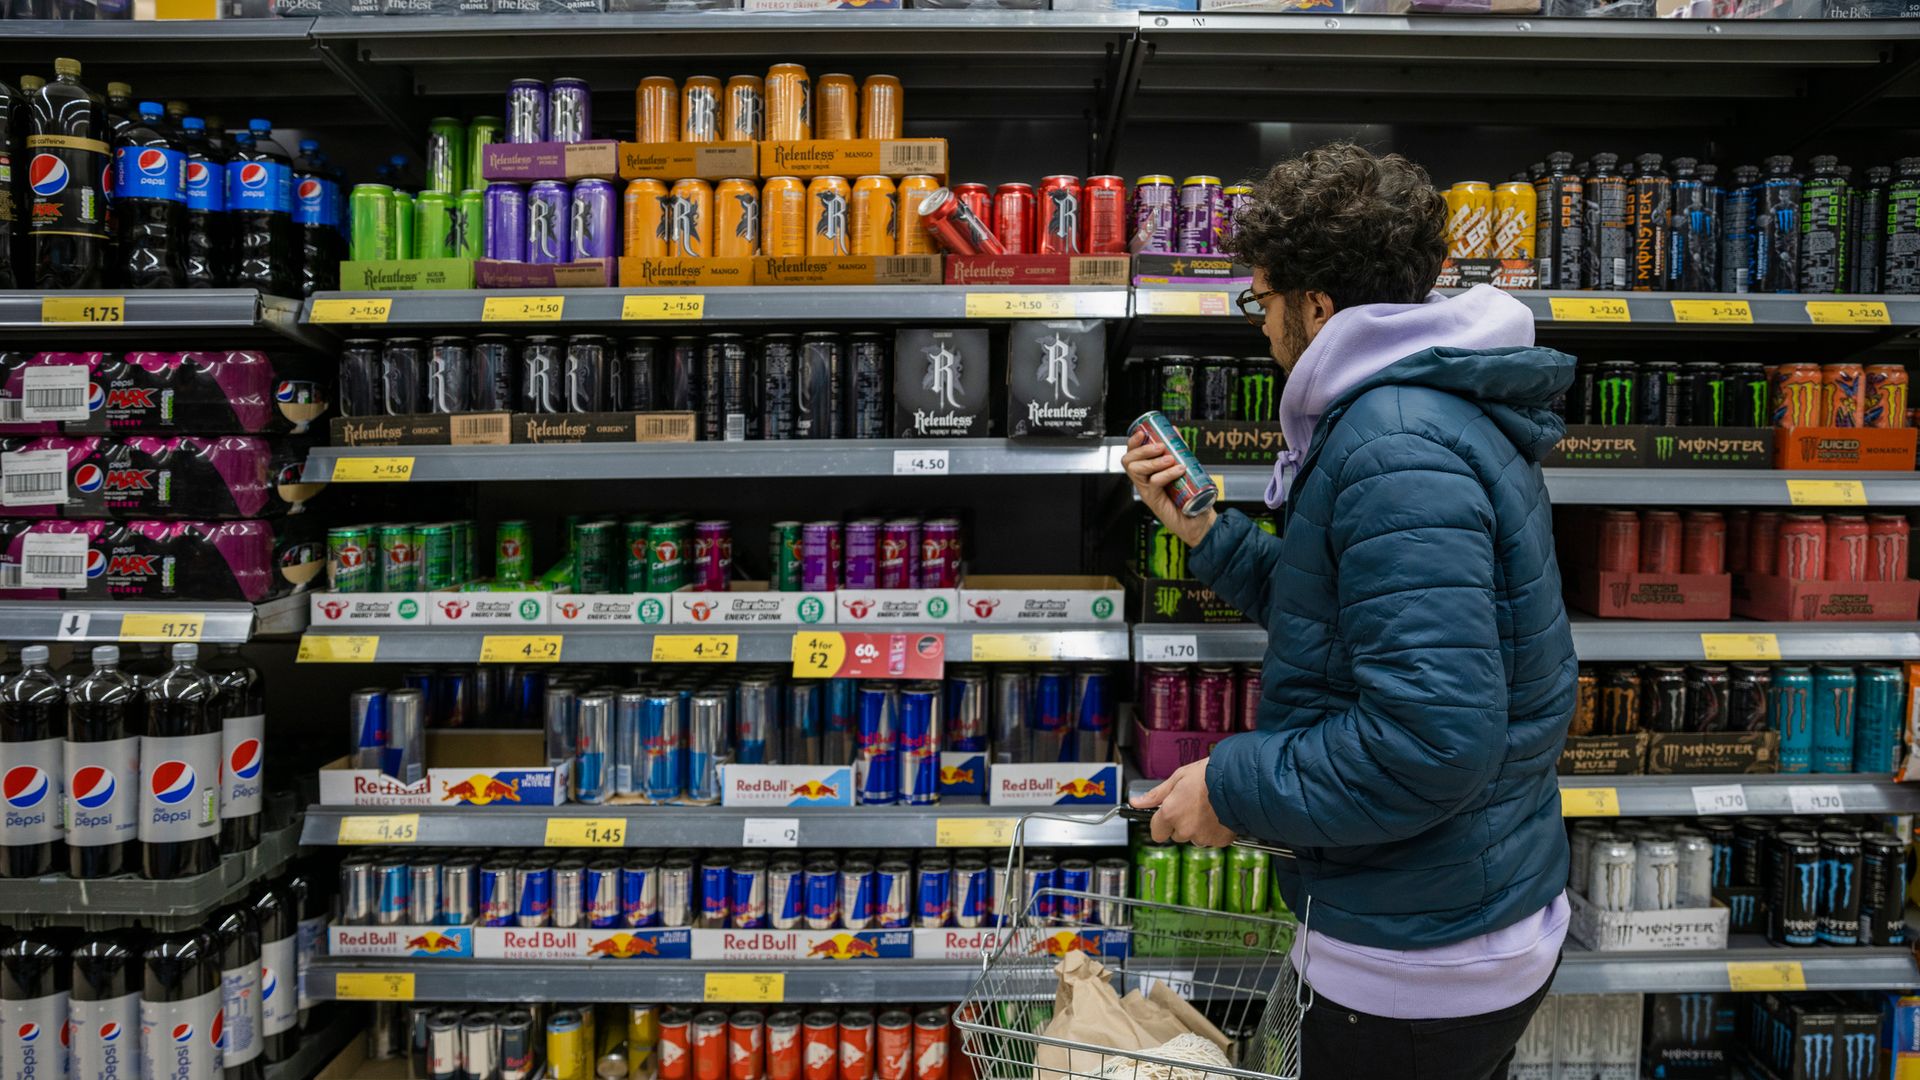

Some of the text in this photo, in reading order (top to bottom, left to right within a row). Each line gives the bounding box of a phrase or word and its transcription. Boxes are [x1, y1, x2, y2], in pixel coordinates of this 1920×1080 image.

[409, 0, 433, 10] Best
[498, 0, 540, 10] the Best
[1831, 6, 1848, 18] the
[627, 154, 667, 170] Relentless
[774, 145, 834, 169] Relentless
[1637, 191, 1653, 279] MONSTER
[642, 259, 701, 284] Relentless
[767, 257, 828, 281] Relentless
[954, 260, 1015, 284] Relentless
[364, 268, 417, 290] Relentless
[1491, 276, 1537, 287] ALERT
[350, 307, 385, 315] 2 £1.50
[523, 304, 559, 313] 2 £1.50
[663, 302, 699, 311] 2 £1.50
[1006, 301, 1042, 310] 2 £1.50
[1590, 306, 1624, 314] 2 £2.50
[1712, 308, 1747, 316] 2 £2.50
[83, 307, 119, 322] £1.75
[1848, 309, 1883, 318] 2 £2.50
[111, 380, 134, 388] pepsi
[105, 388, 159, 409] MAX
[1027, 400, 1088, 427] Relentless
[913, 408, 973, 435] Relentless
[343, 422, 402, 446] Relentless
[527, 418, 586, 443] Relentless
[1554, 436, 1636, 452] MONSTER
[1678, 437, 1765, 453] MONSTER
[1818, 440, 1859, 449] JUICED
[109, 461, 131, 469] pepsi
[373, 465, 408, 474] 2 £1.50
[912, 459, 945, 469] £4.50
[103, 469, 156, 489] MAX
[112, 546, 135, 554] pepsi
[106, 555, 160, 575] MAX
[523, 604, 536, 613] 63
[642, 604, 659, 616] 63
[802, 602, 819, 615] 63
[932, 603, 945, 612] 63
[1096, 602, 1110, 611] 63
[162, 623, 197, 638] £1.75
[522, 643, 557, 656] 4 £2
[693, 642, 729, 655] 4 £2
[809, 639, 833, 650] 4 for
[1165, 645, 1195, 656] £1.70
[855, 644, 879, 659] 60p
[810, 653, 828, 669] £2
[1563, 748, 1629, 759] MONSTER
[1682, 743, 1754, 756] MONSTER
[1574, 761, 1617, 769] MULE
[737, 780, 787, 792] Red Bull
[1002, 778, 1053, 791] Red Bull
[400, 797, 431, 805] DRINK
[1715, 795, 1744, 808] £1.70
[1811, 796, 1840, 808] £1.70
[6, 813, 45, 828] pepsi
[75, 814, 113, 828] pepsi
[153, 810, 191, 824] pepsi
[378, 825, 413, 839] £1.45
[586, 829, 621, 842] £1.45
[784, 829, 796, 841] £2
[1637, 923, 1714, 935] MONSTER
[340, 932, 397, 945] Red Bull
[505, 932, 576, 948] Red Bull
[724, 933, 796, 950] Red Bull
[946, 932, 980, 949] Red
[504, 951, 576, 959] ENERGY DRINK
[1662, 1049, 1723, 1060] MONSTER
